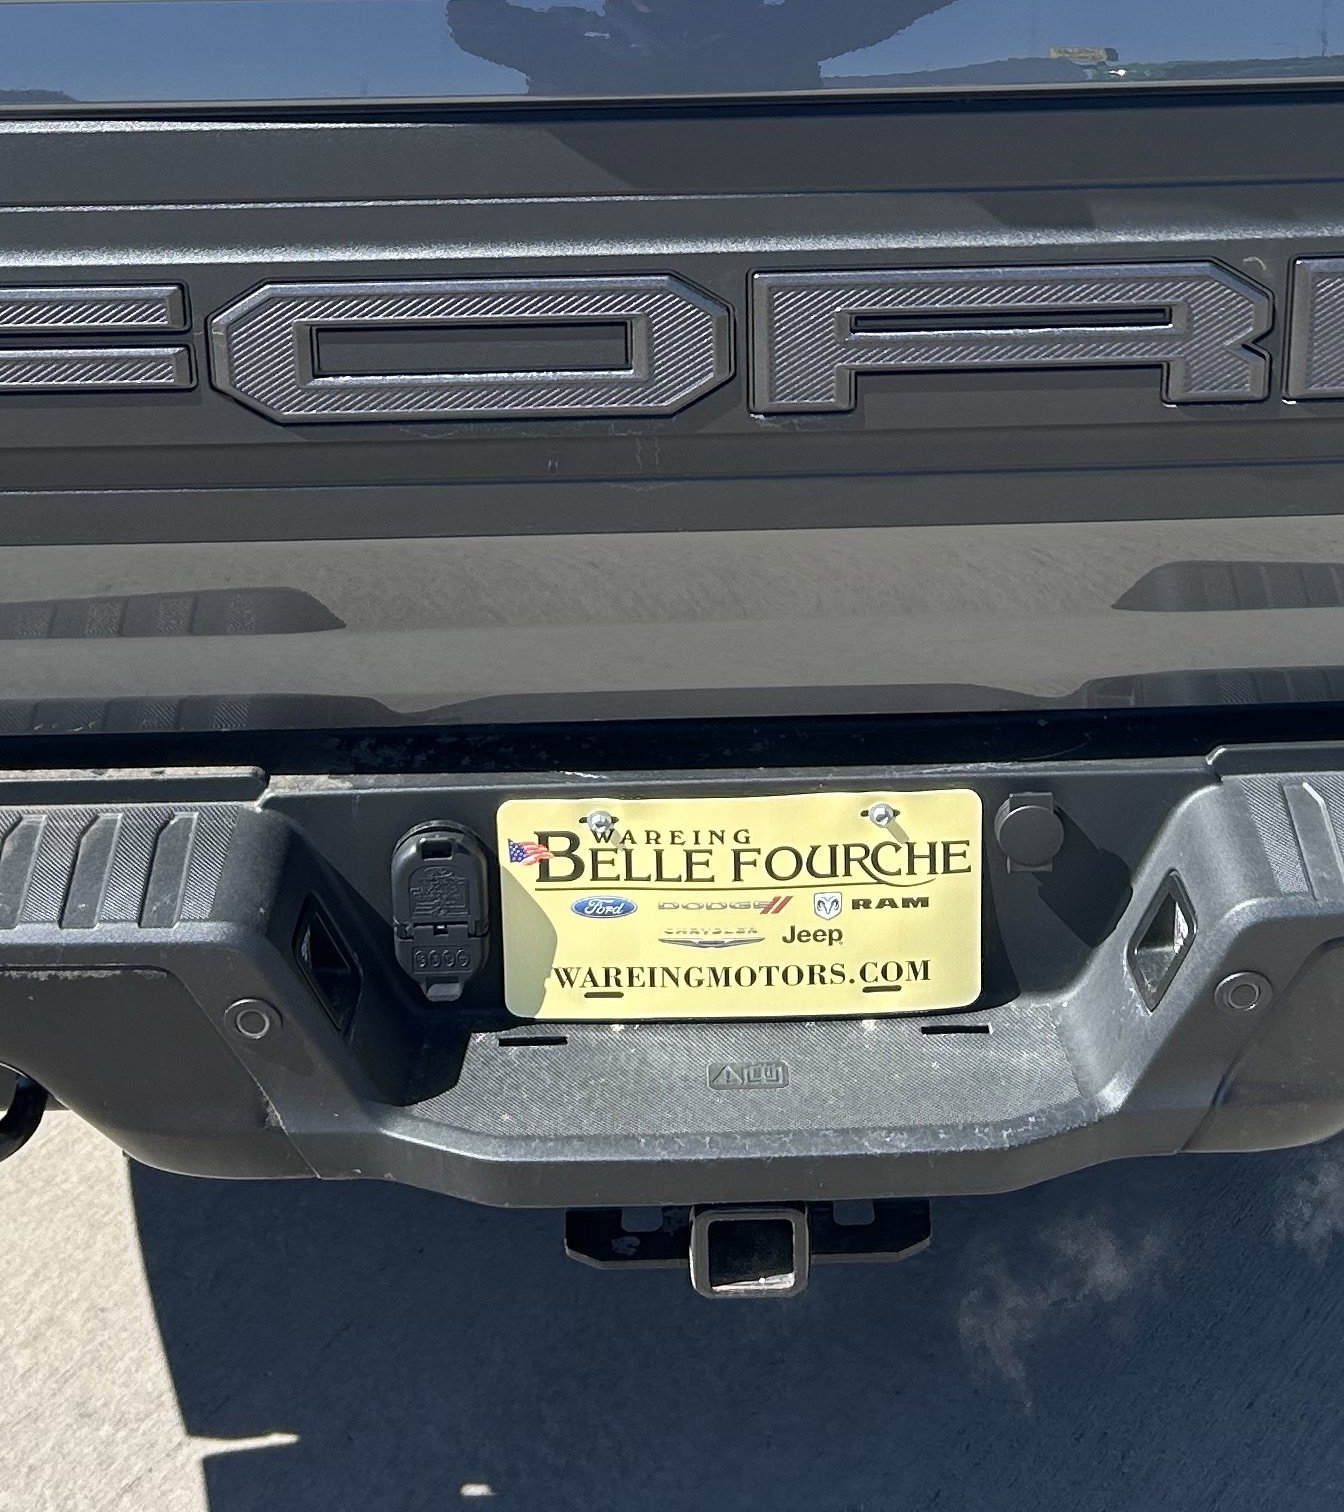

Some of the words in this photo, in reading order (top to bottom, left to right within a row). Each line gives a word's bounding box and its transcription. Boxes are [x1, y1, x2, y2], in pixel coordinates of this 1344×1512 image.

[590, 828, 751, 846] WAREING
[534, 830, 715, 884] BELLE
[732, 840, 972, 887] FOURCHE
[580, 897, 629, 918] Ford
[658, 900, 777, 911] DODGE
[851, 896, 930, 910] RAM
[781, 925, 843, 946] Jeep
[552, 960, 932, 988] WAREINGMOTORS.COM
